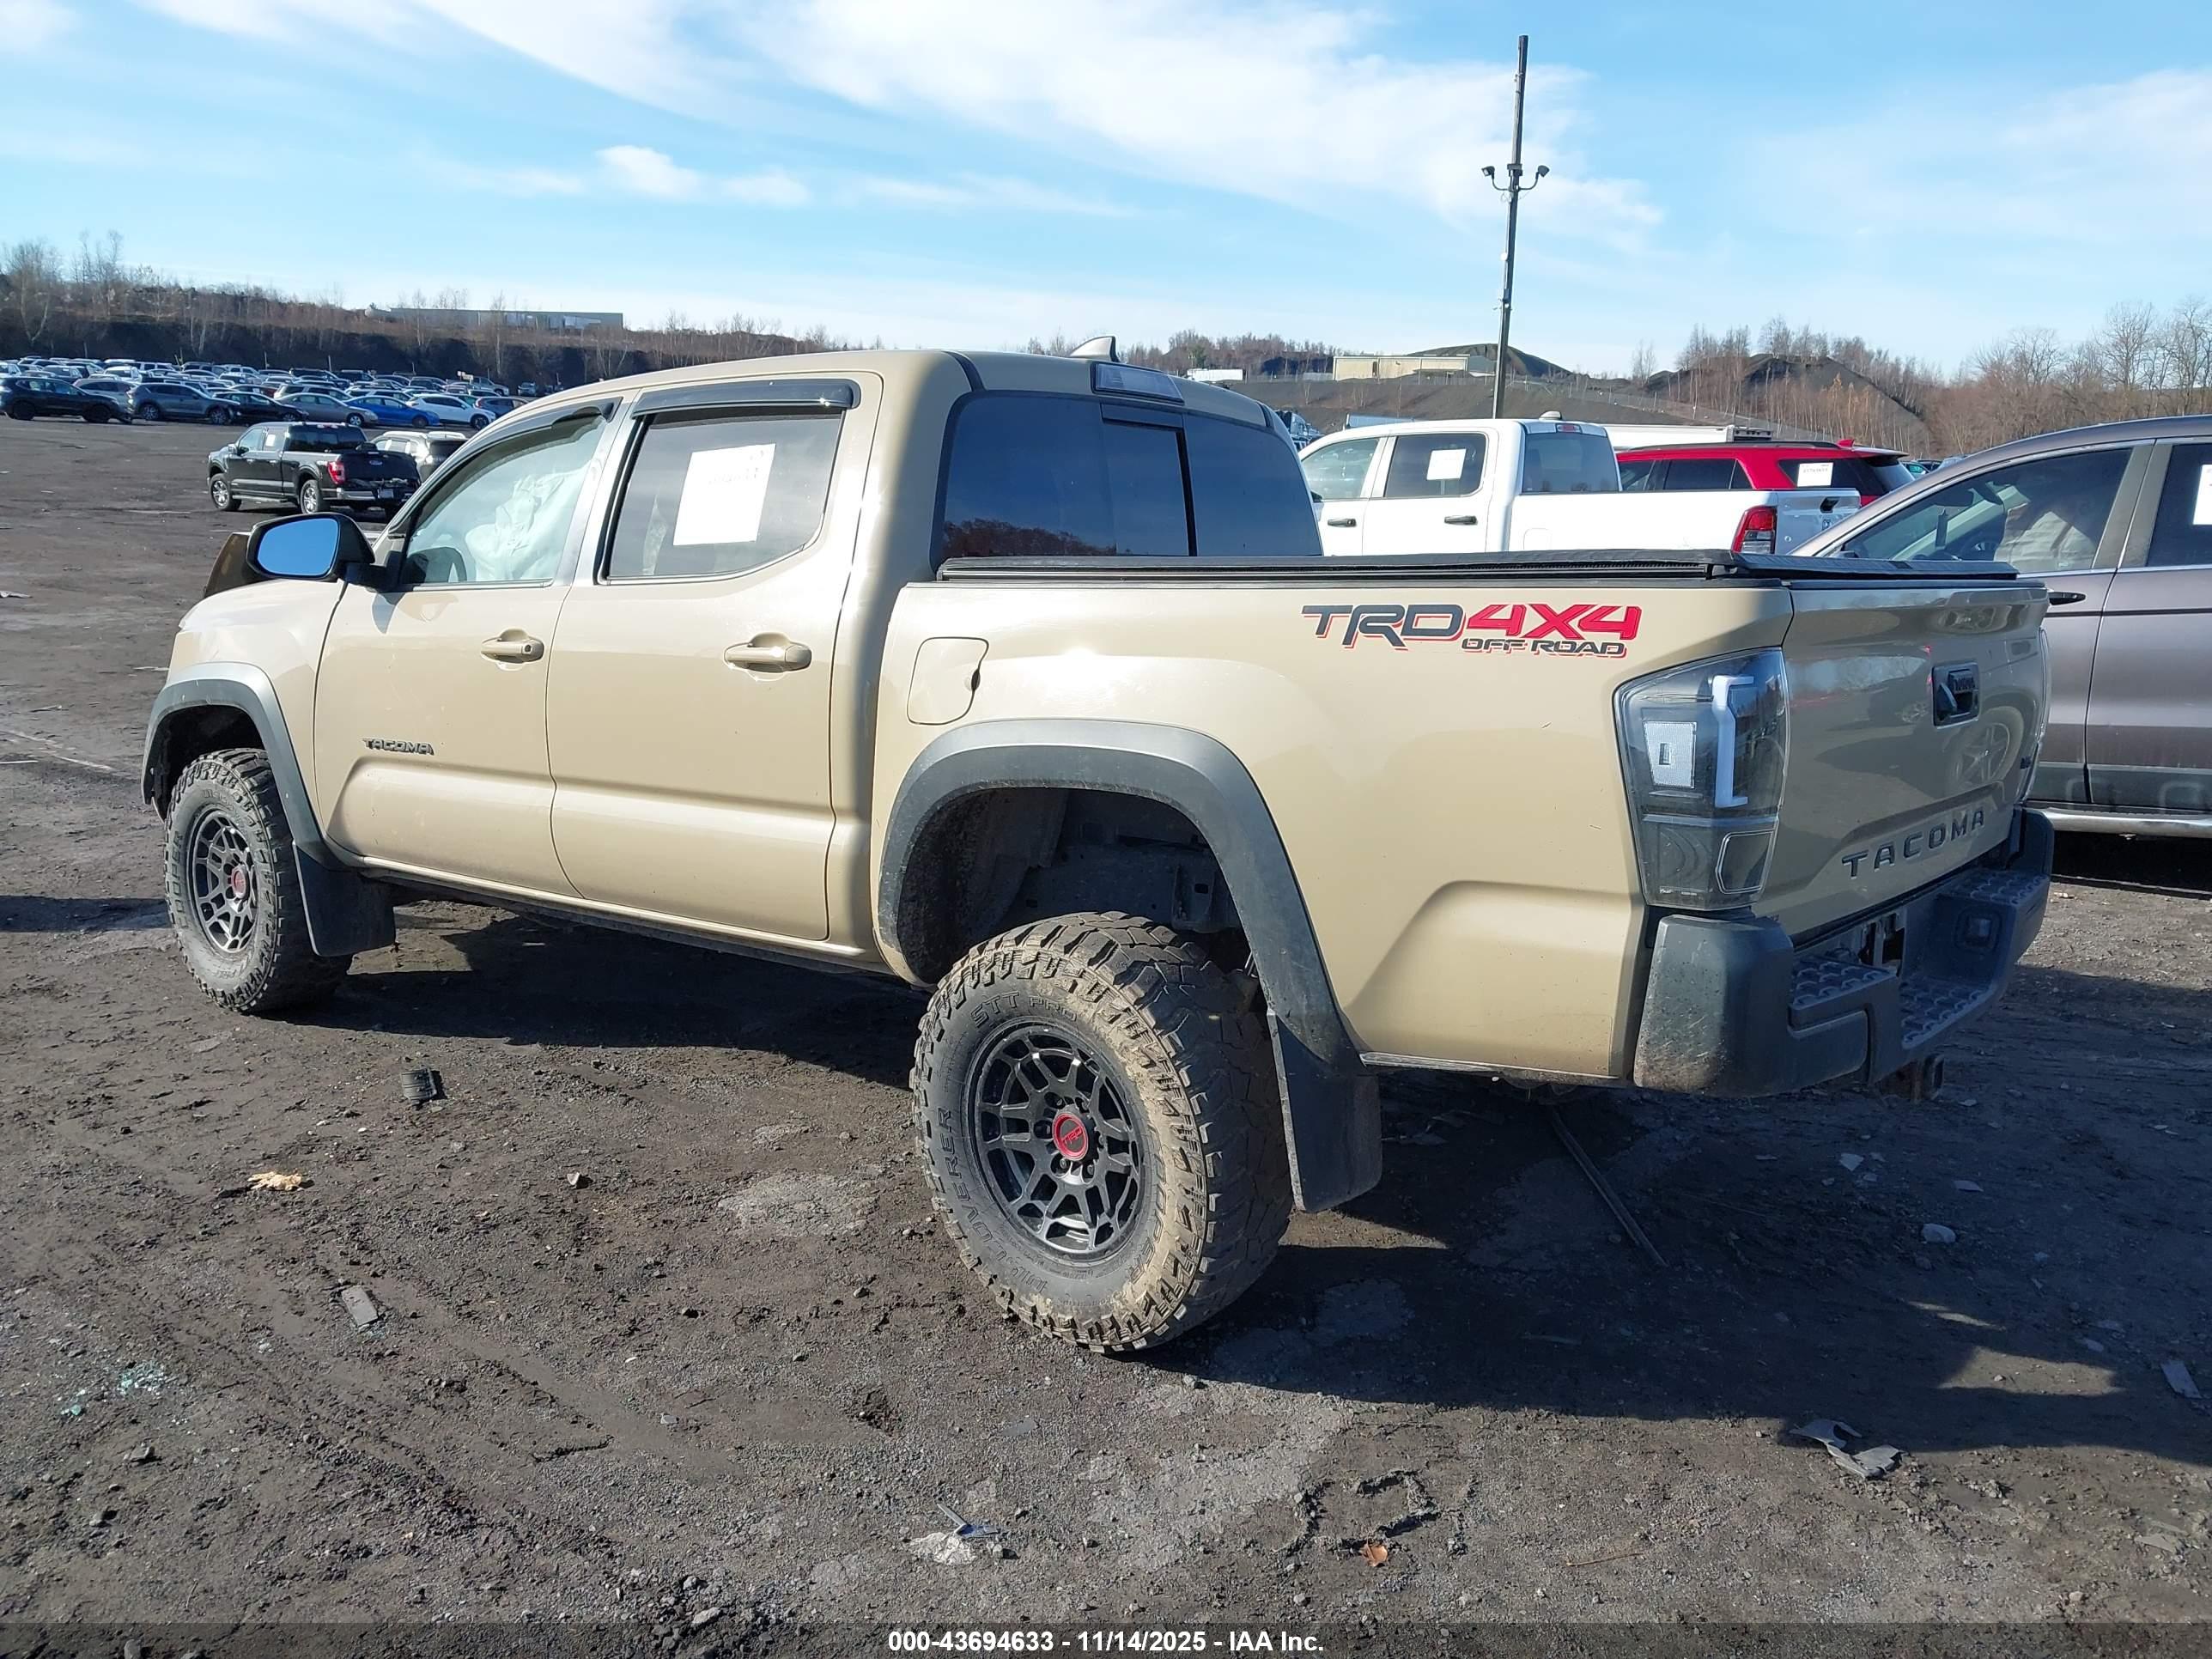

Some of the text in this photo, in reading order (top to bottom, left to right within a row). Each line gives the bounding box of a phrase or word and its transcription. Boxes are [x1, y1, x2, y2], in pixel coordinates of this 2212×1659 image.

[1302, 604, 1468, 650] TRD
[1461, 638, 1628, 659] OFF ROAD
[362, 738, 434, 756] TACOMA
[1841, 806, 1984, 879] TACOMA
[970, 991, 1078, 1029] STT PRO
